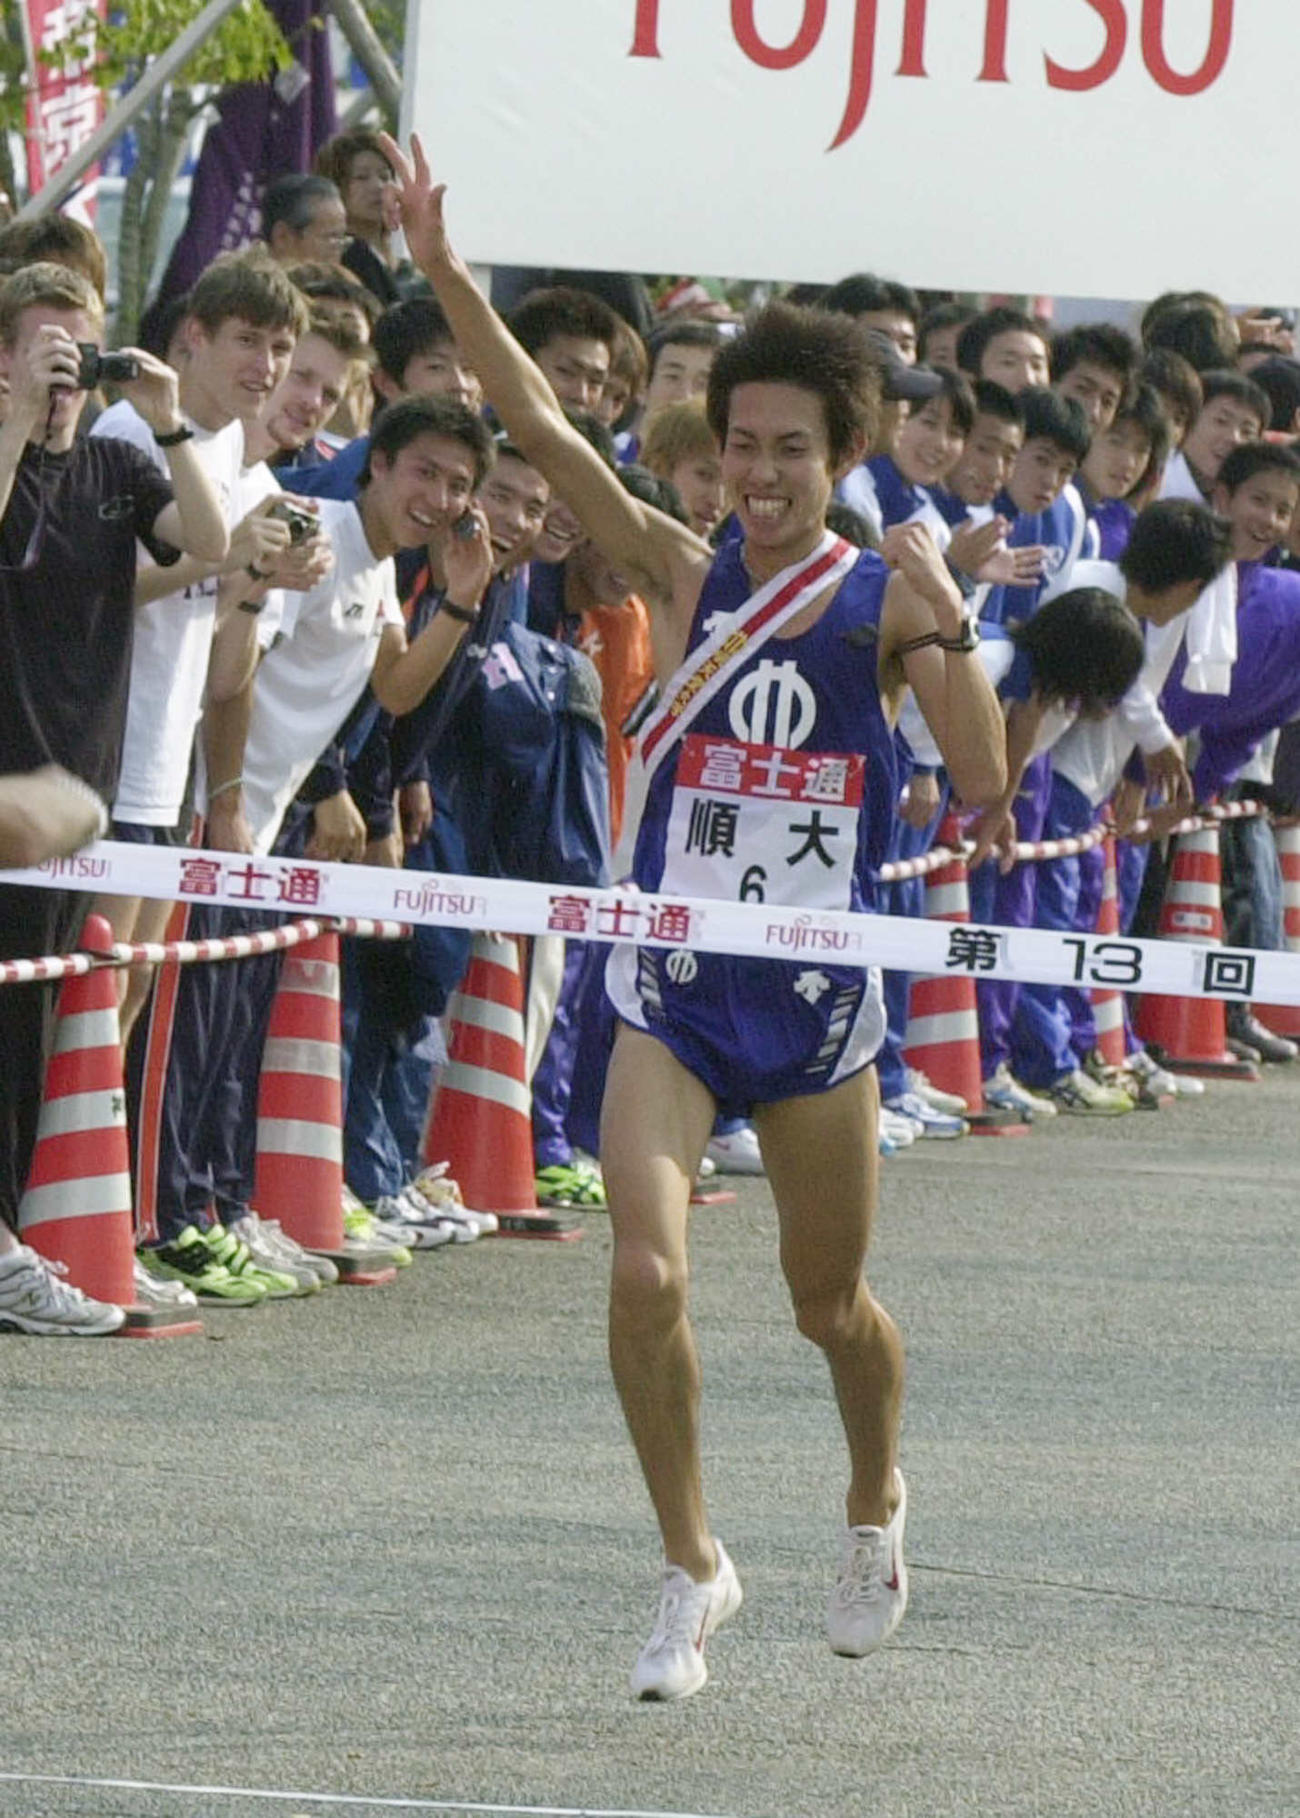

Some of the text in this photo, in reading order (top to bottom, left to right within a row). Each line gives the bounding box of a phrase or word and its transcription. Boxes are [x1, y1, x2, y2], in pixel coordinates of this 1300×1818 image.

[700, 744, 848, 802] 富士通
[179, 857, 321, 905] 富士通
[394, 888, 475, 917] FUJITSU
[739, 864, 768, 903] 6
[548, 895, 690, 943] 富士通
[765, 923, 849, 952] FUJITSU
